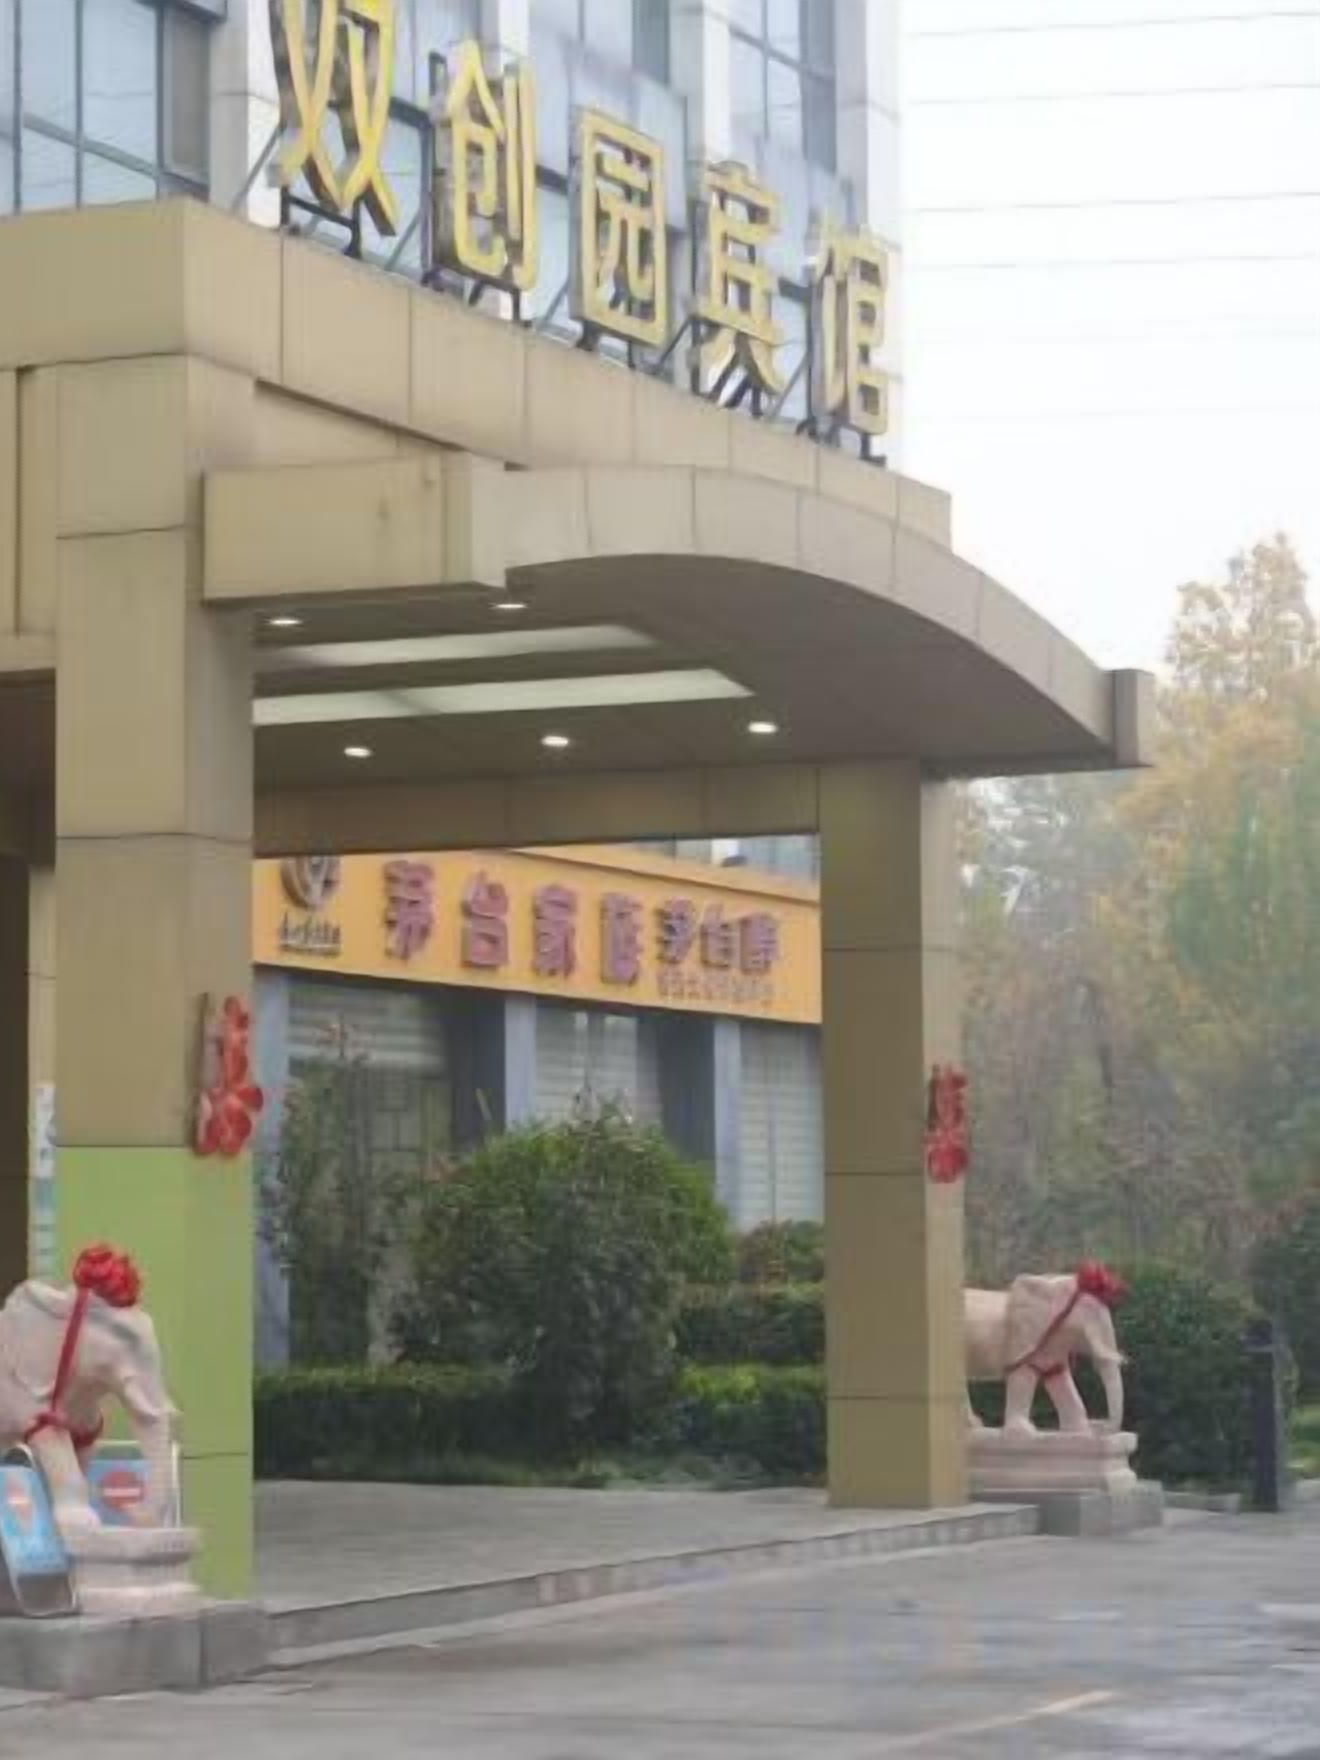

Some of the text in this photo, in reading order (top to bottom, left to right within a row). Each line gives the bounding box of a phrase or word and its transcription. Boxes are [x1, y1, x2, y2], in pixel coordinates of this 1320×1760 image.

[270, 0, 890, 436] 双创园宾馆
